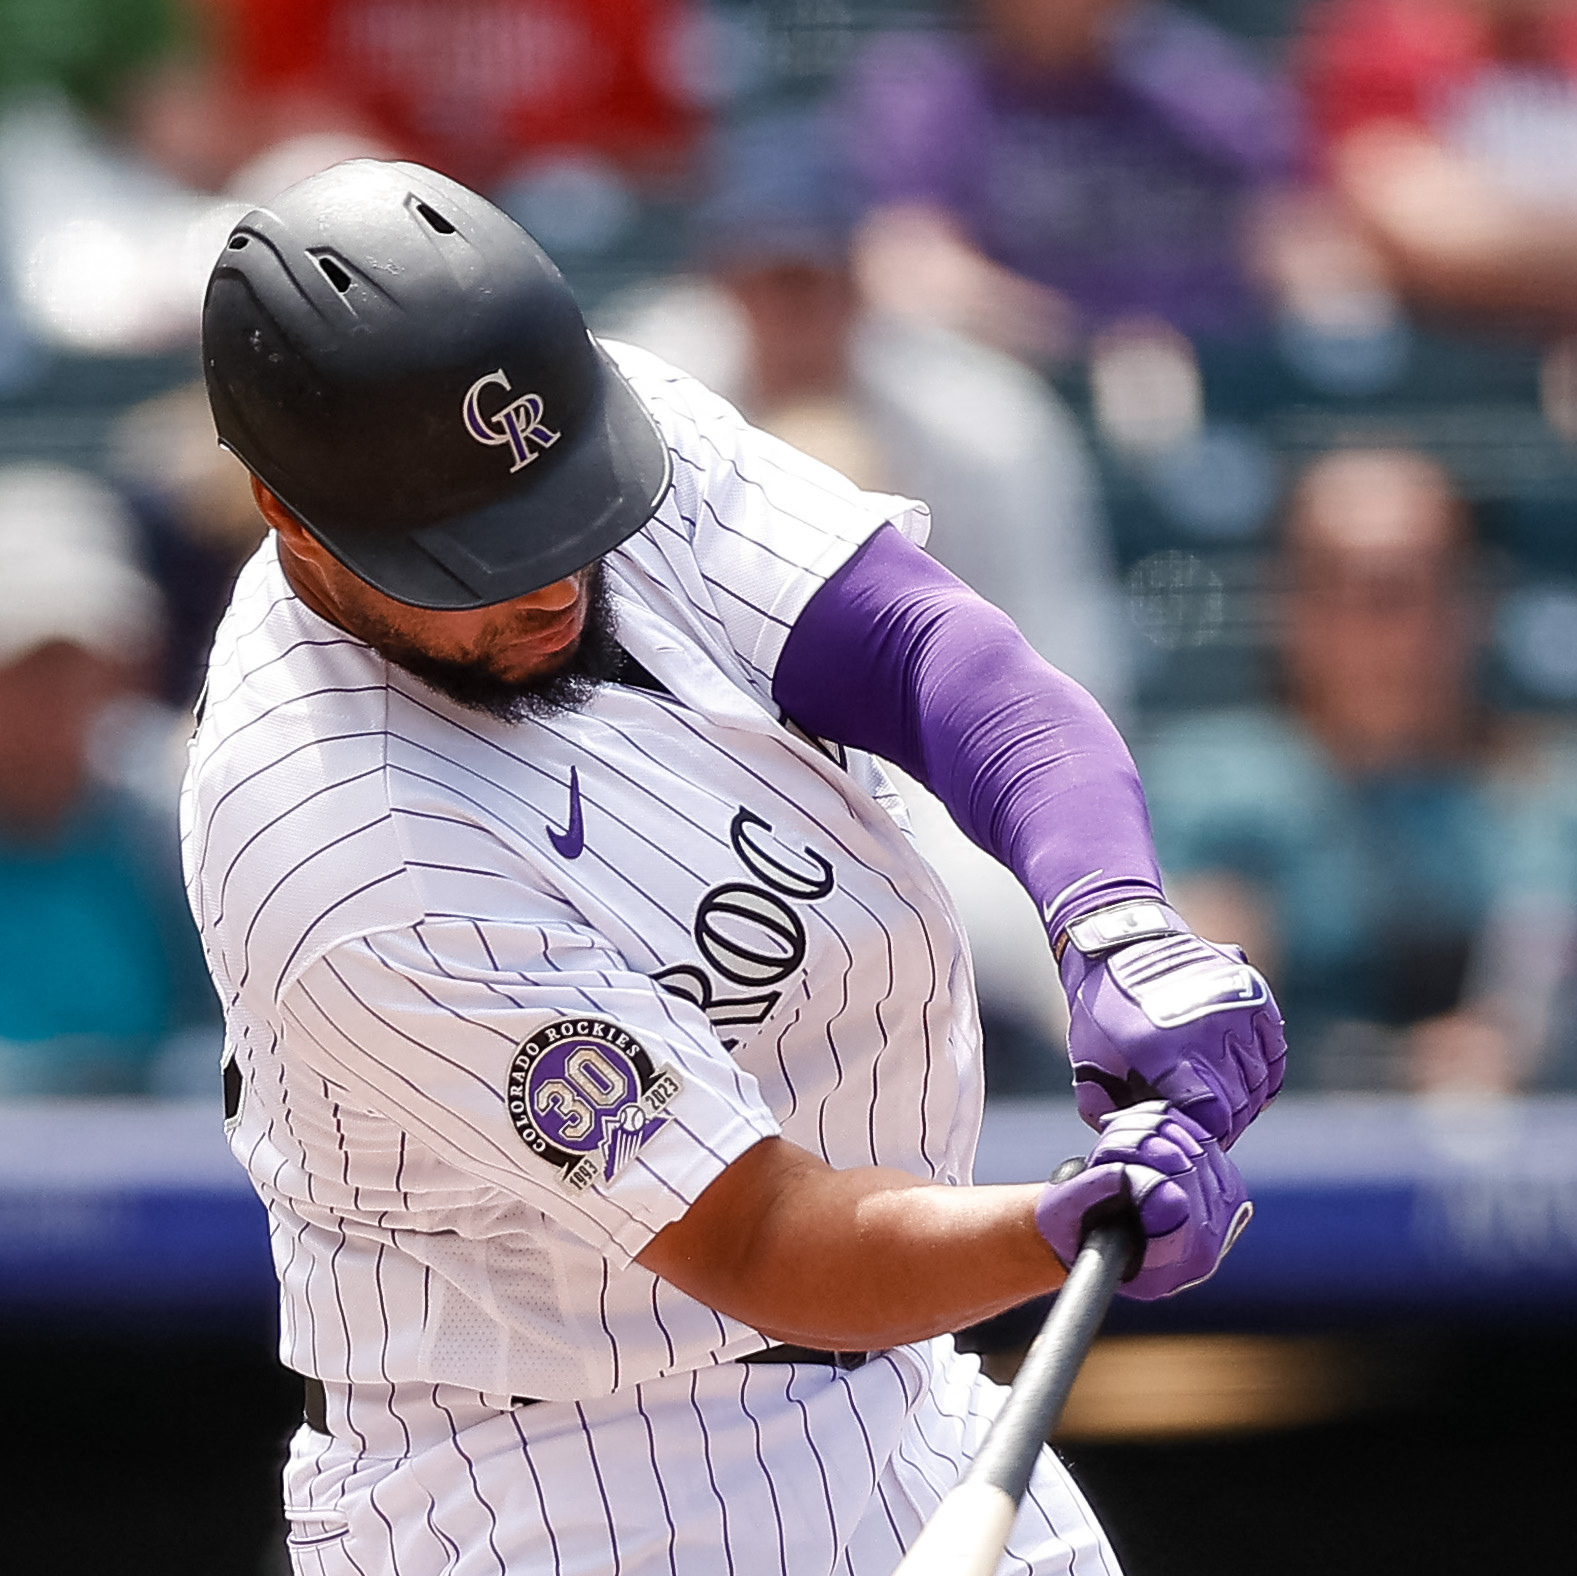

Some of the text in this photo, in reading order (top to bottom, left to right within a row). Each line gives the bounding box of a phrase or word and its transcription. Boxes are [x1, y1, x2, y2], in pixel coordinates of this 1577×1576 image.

[463, 368, 561, 473] CR
[509, 1021, 641, 1153] COLORADO ROCKIES
[534, 1045, 628, 1142] 30
[568, 1075, 680, 1191] 1993 2023
